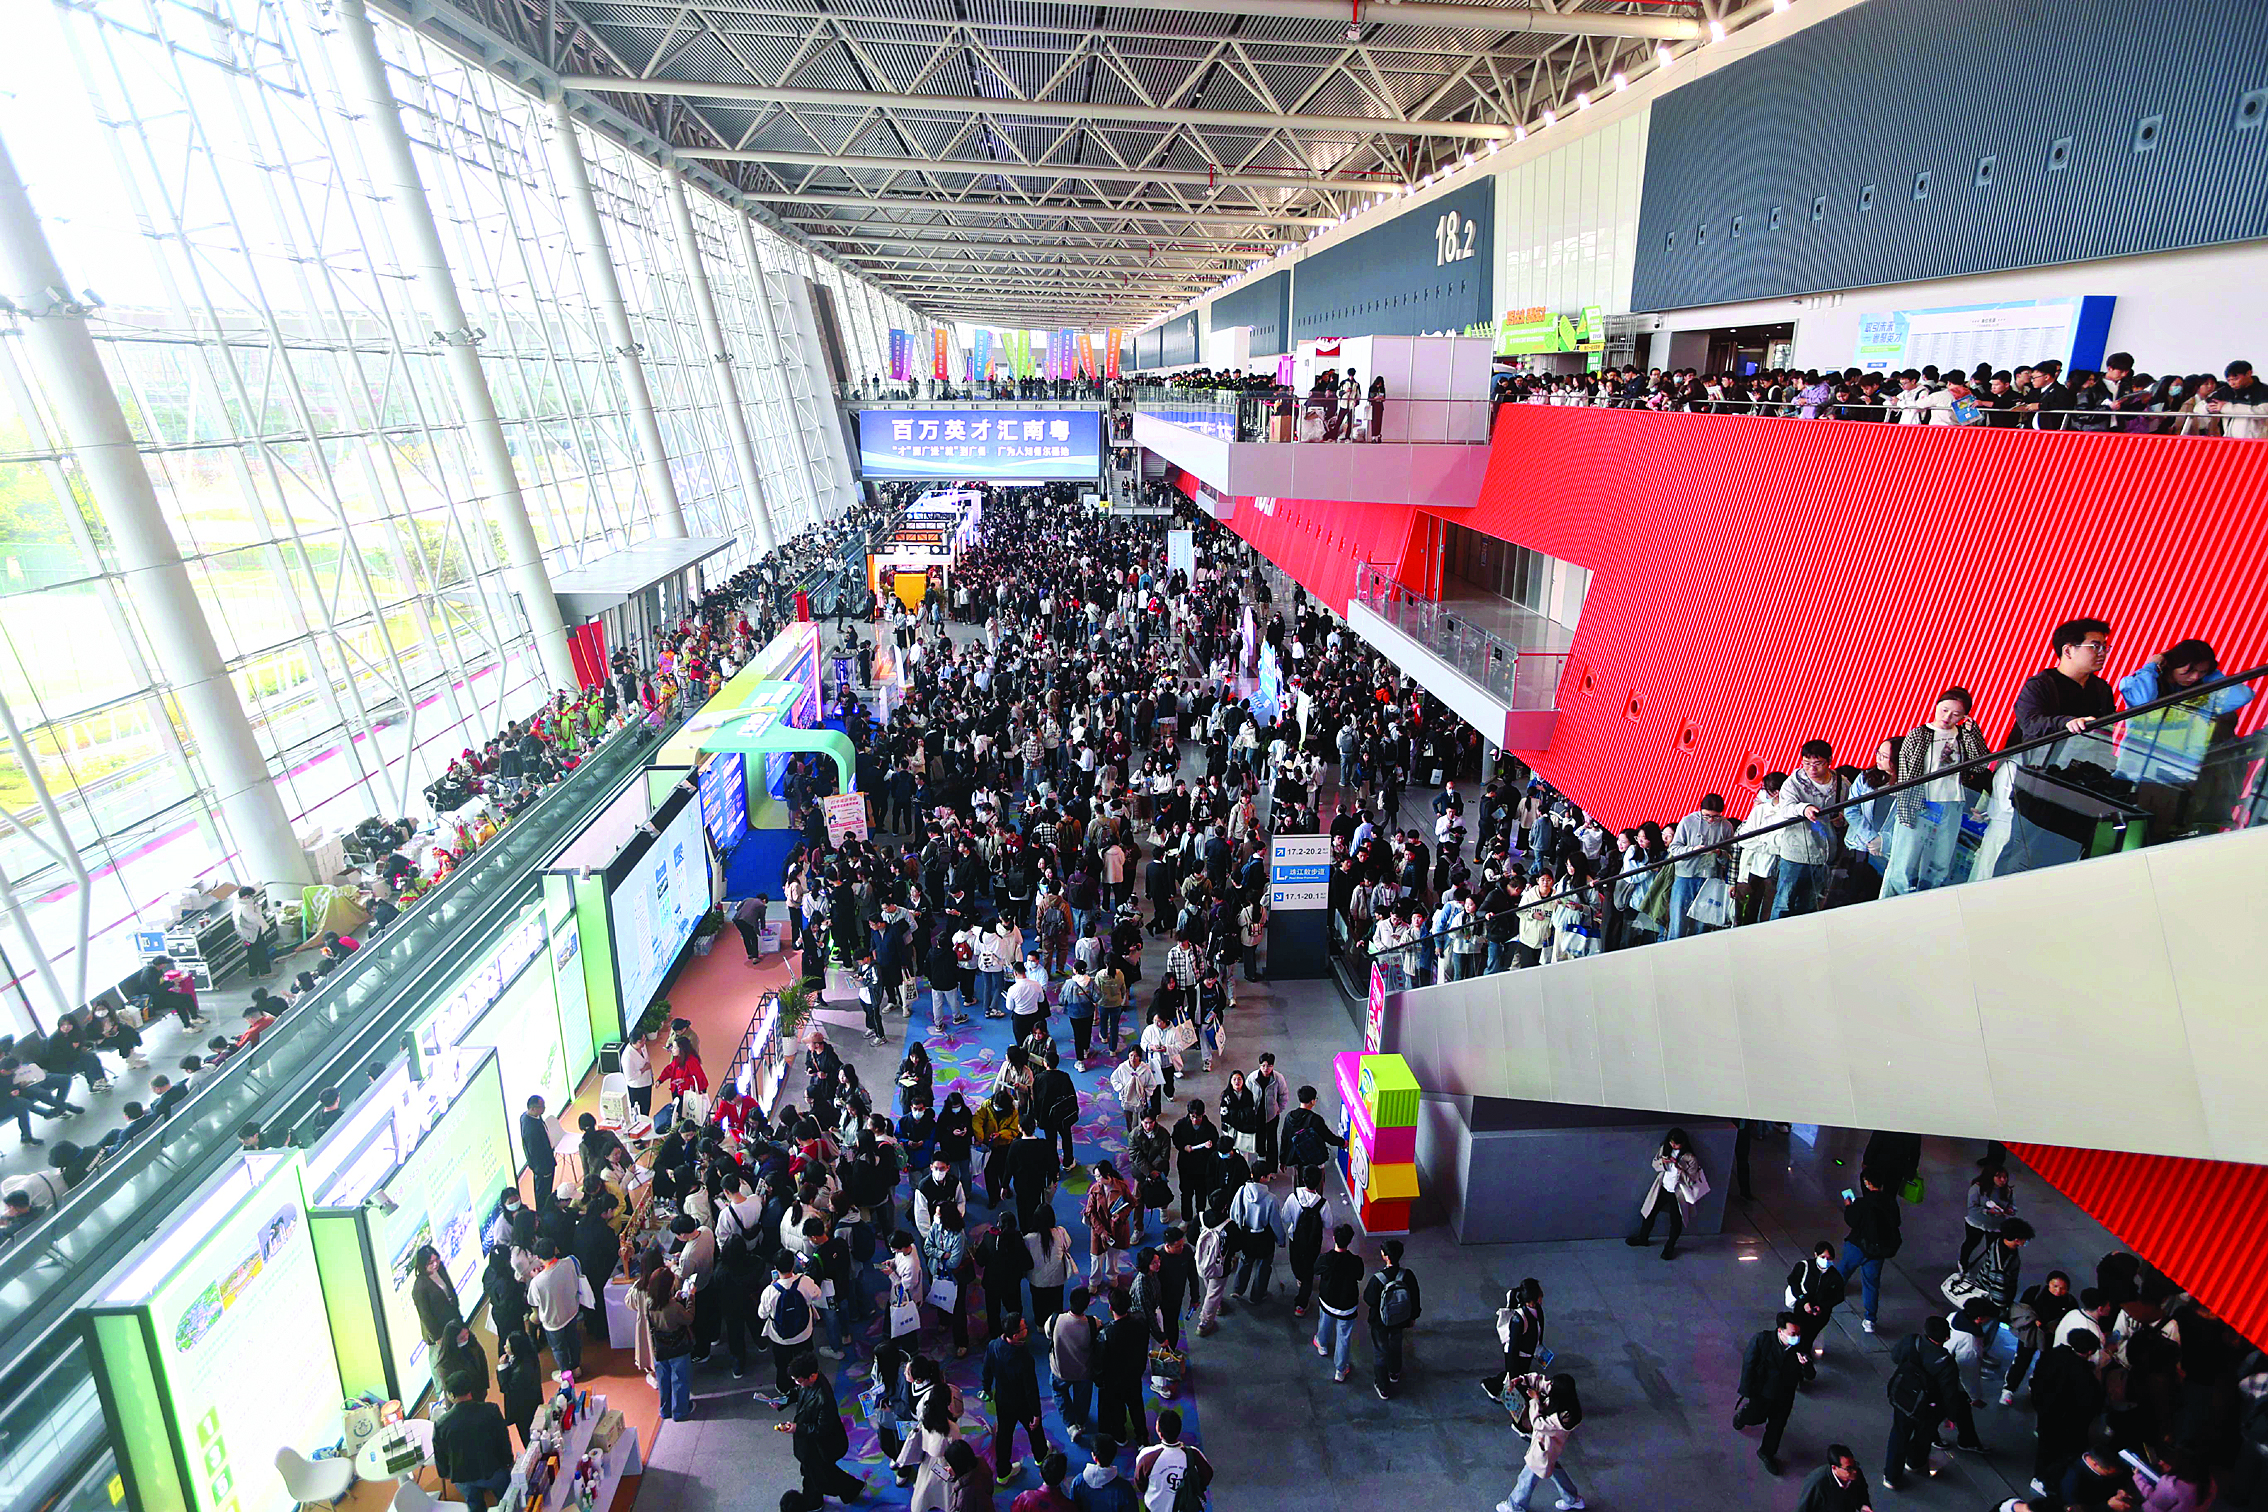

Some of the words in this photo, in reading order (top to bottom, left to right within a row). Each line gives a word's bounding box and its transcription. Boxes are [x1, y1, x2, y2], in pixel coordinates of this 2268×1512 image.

[1435, 210, 1477, 267] 18.2
[892, 418, 1071, 441] 百万英才汇南粤
[1285, 892, 1319, 900] 17.1-20.1
